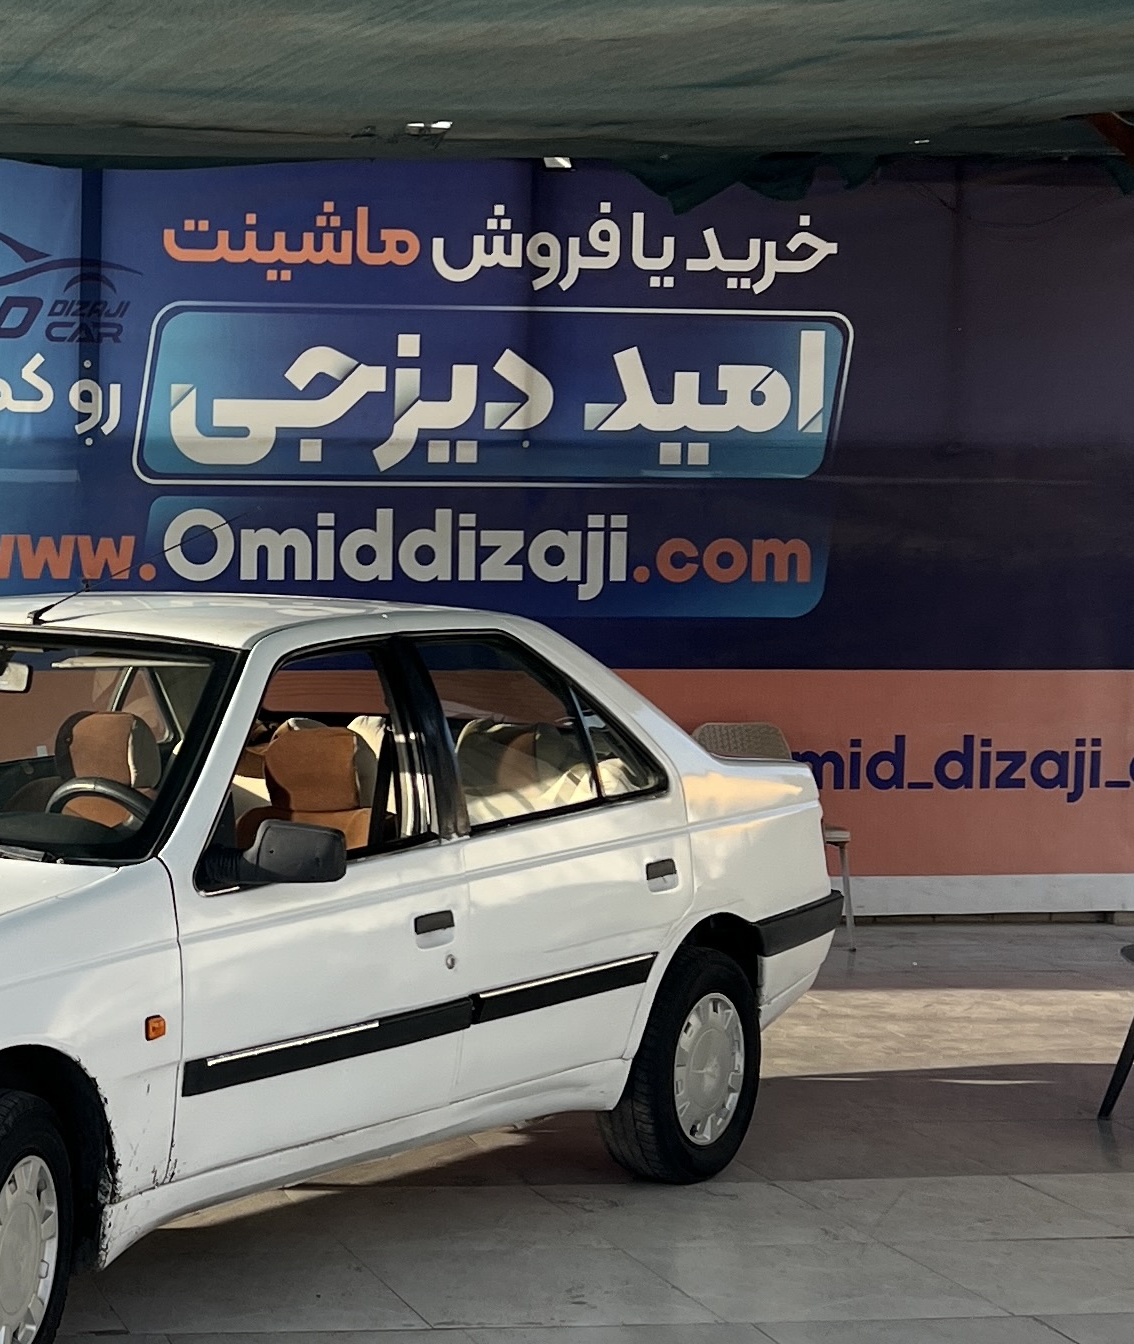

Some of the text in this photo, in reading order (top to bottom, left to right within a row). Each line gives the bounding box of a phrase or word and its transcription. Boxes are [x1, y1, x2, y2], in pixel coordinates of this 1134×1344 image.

[162, 201, 839, 296] خرید یا فروش ماشینت
[44, 321, 123, 344] CAR
[47, 299, 131, 319] DIZAJI
[68, 376, 122, 436] رو
[169, 329, 826, 472] امید دیزجی
[792, 733, 1134, 804] mid_dizaji_
